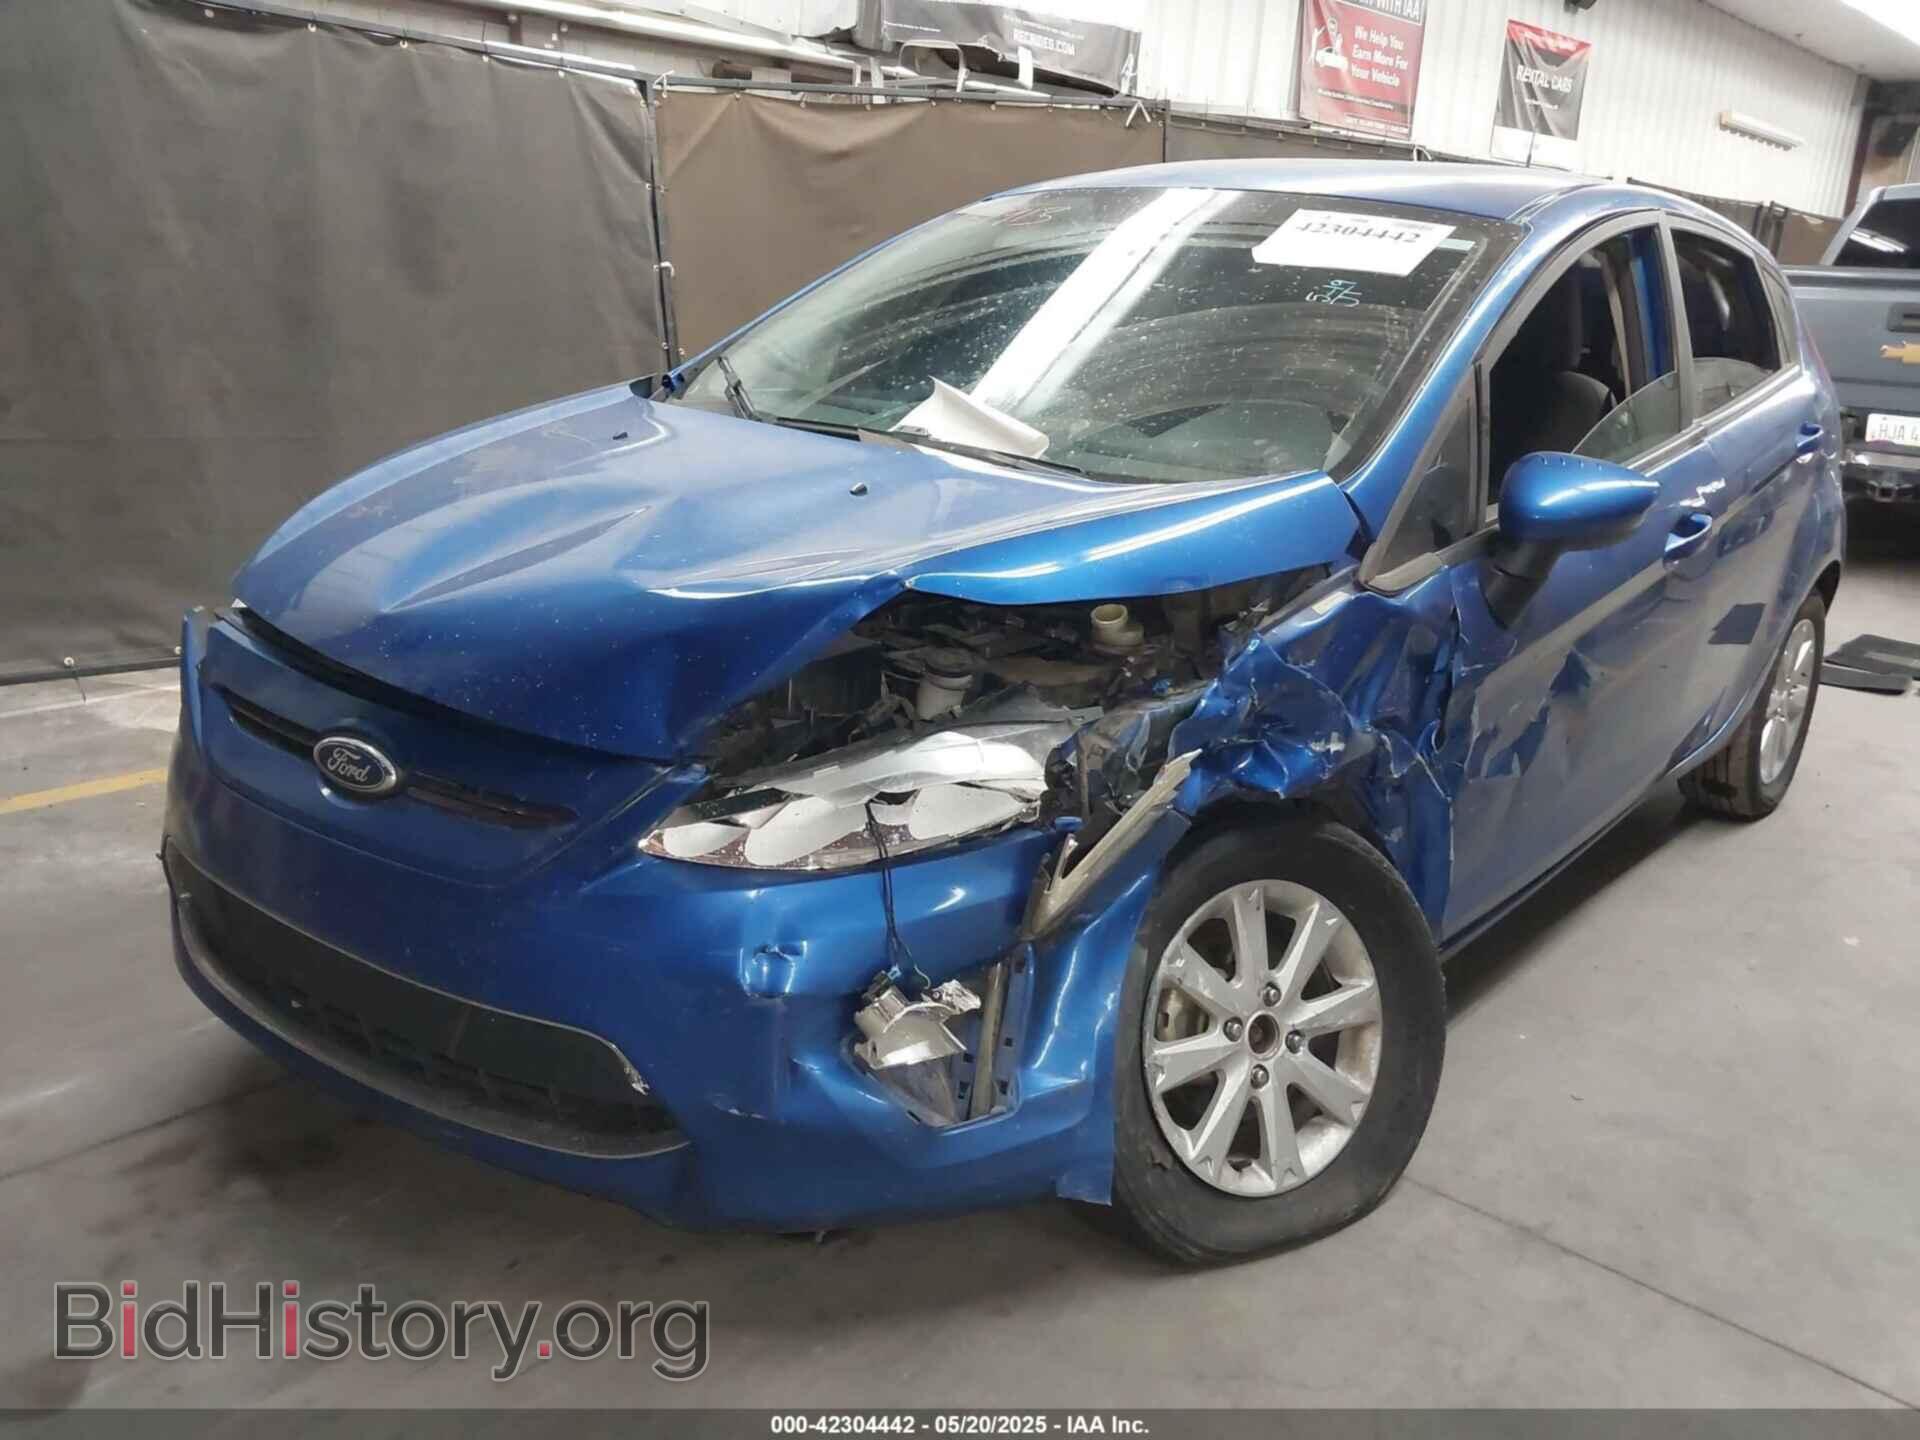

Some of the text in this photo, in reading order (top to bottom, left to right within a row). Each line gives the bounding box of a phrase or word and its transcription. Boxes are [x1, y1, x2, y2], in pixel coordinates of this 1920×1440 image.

[1354, 25, 1404, 50] We Help You
[1352, 44, 1408, 70] Earn More For
[1351, 62, 1400, 87] Your Vehicle
[1295, 222, 1421, 243] 42304442
[327, 746, 371, 783] Ford
